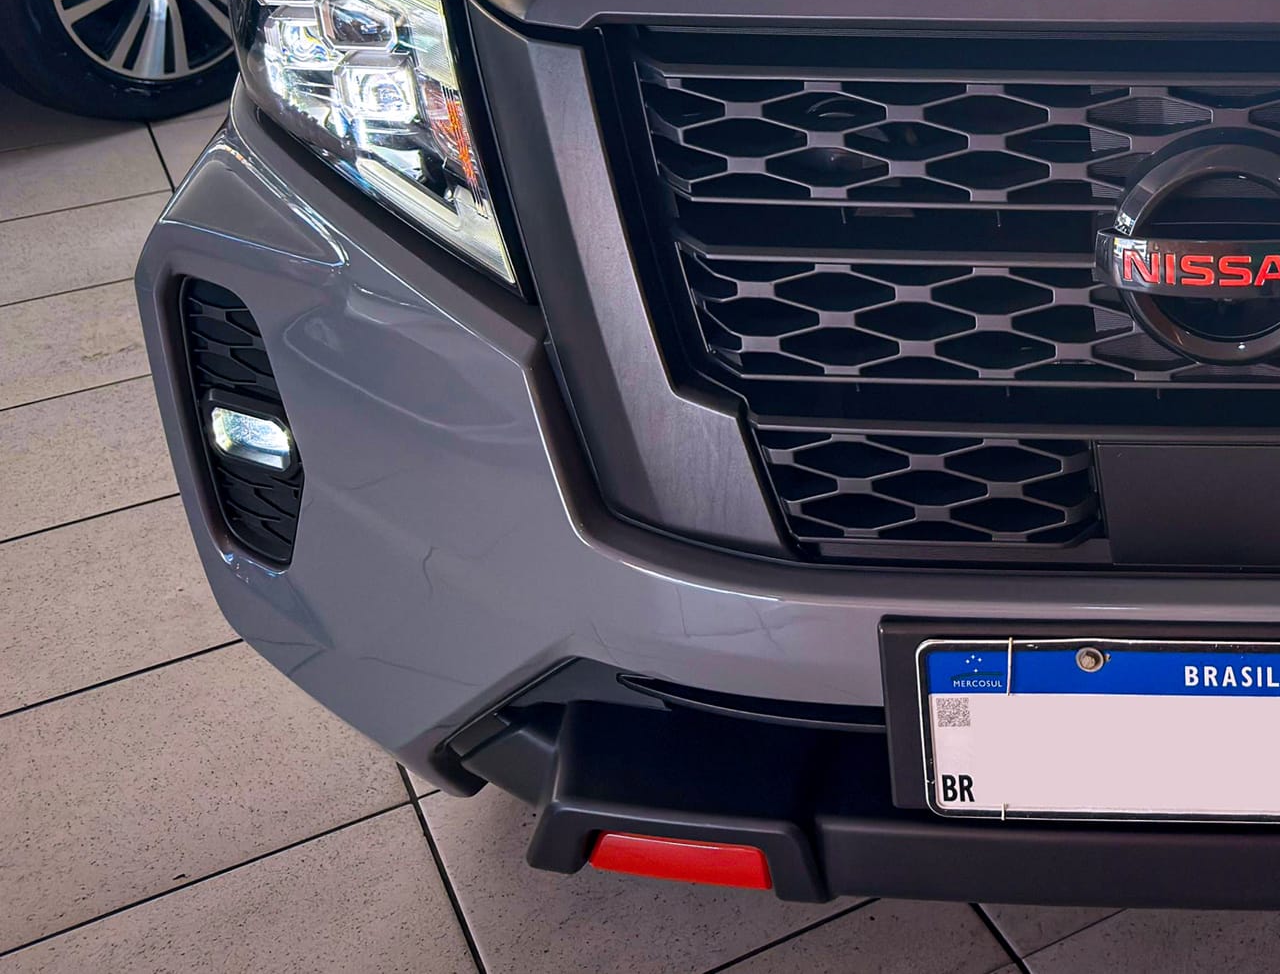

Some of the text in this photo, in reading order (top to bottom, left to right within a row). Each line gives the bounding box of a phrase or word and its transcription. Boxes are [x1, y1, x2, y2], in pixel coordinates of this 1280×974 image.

[953, 679, 1003, 688] MERCOSUL
[1184, 665, 1280, 688] BRASIL
[941, 774, 975, 802] BR
